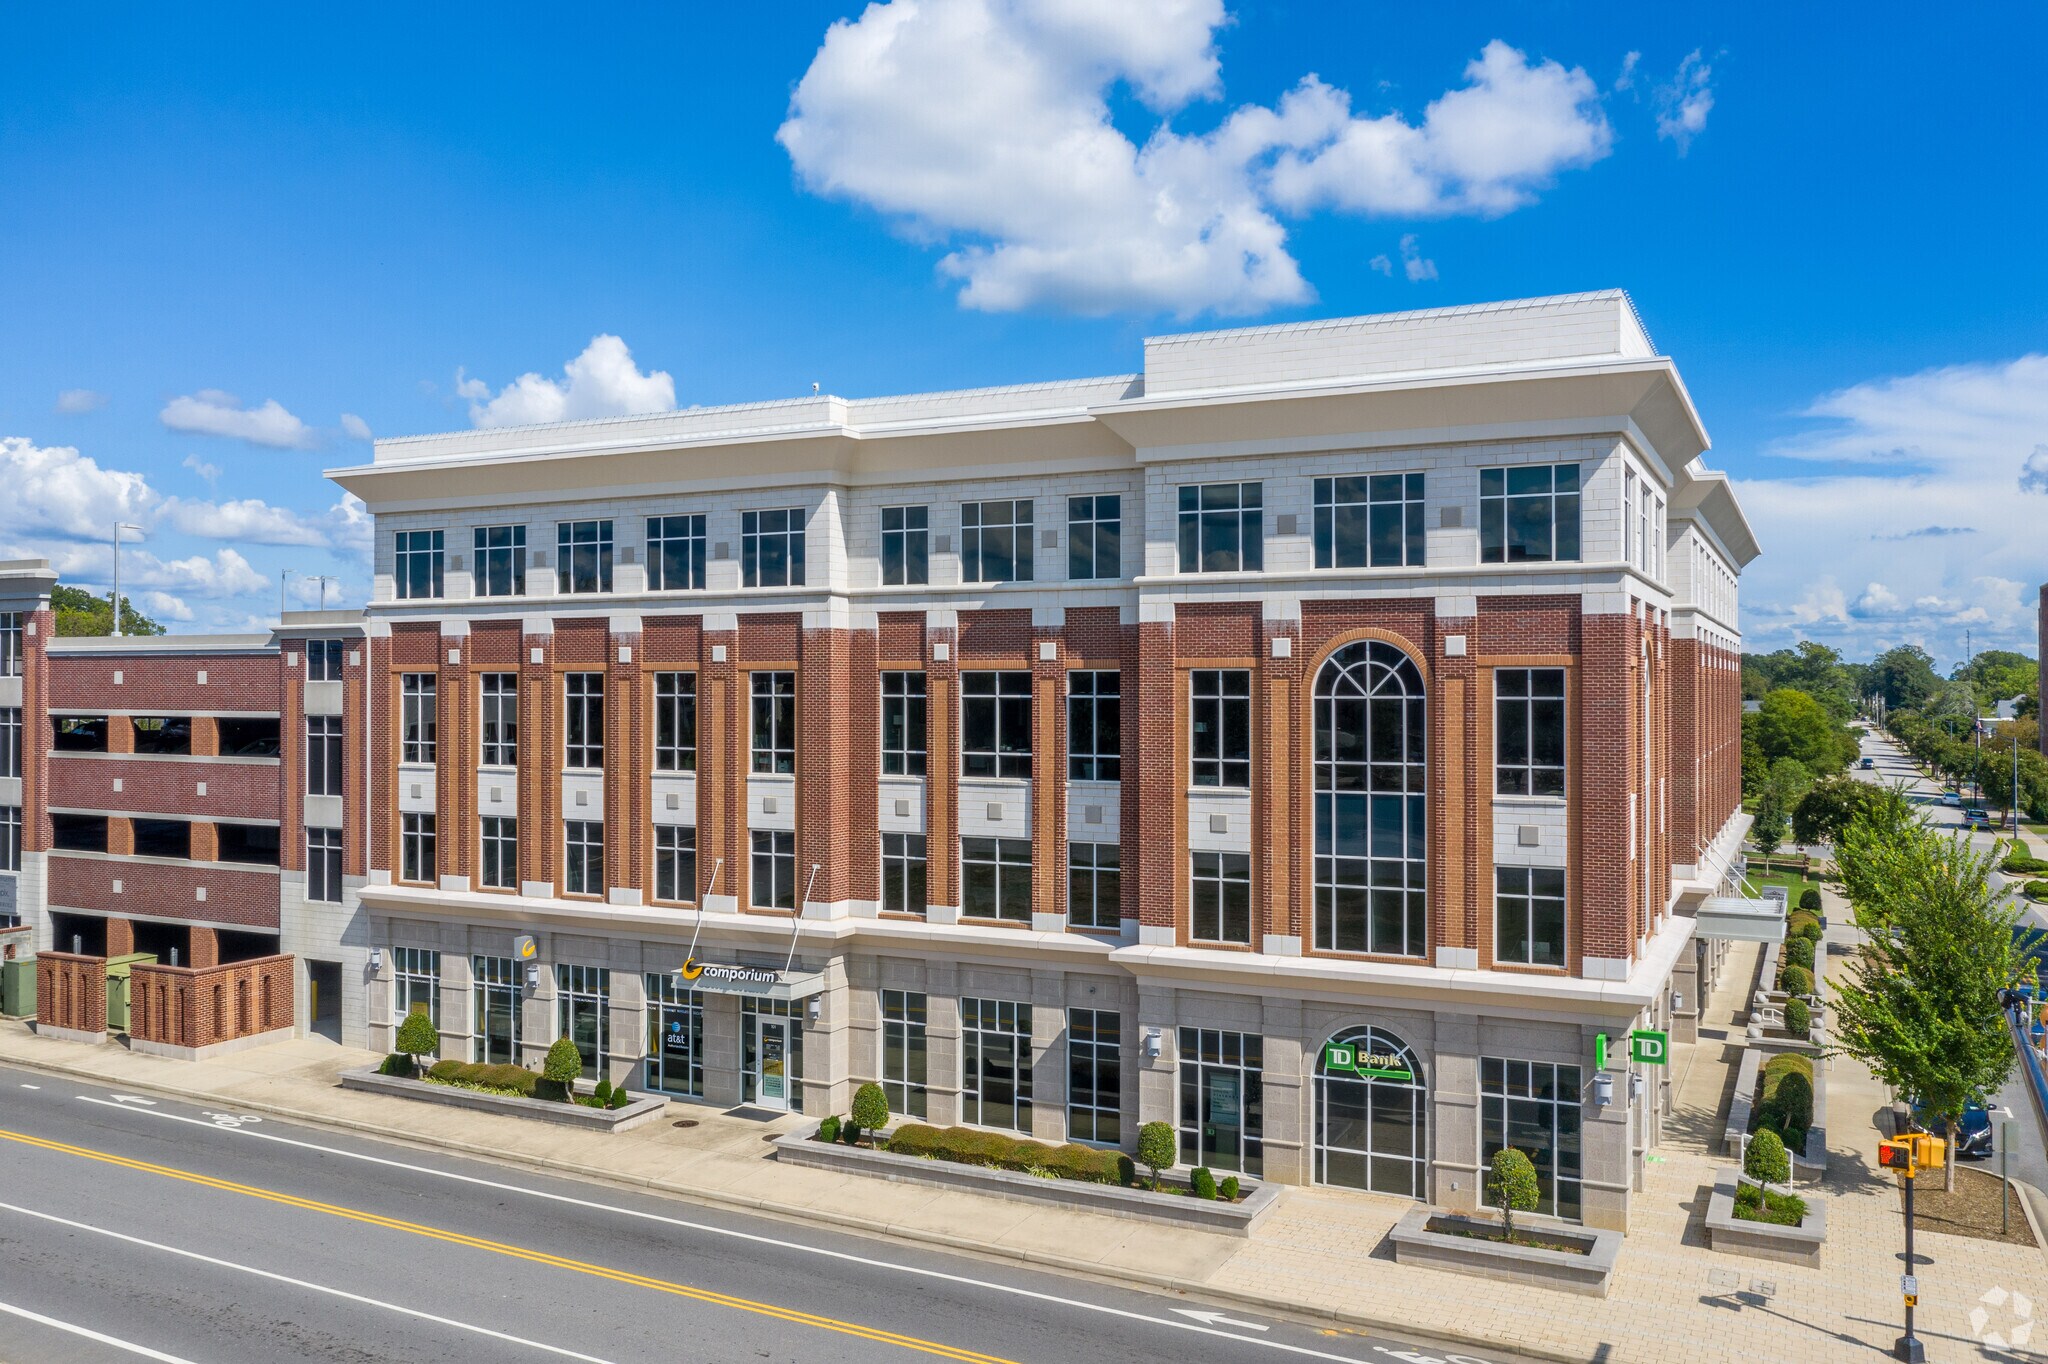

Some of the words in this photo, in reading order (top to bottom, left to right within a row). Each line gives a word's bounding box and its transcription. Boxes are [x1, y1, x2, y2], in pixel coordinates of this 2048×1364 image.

[703, 967, 775, 983] comporium
[667, 1033, 685, 1044] at&t
[1634, 1037, 1663, 1058] TD
[1329, 1048, 1351, 1065] TD
[1358, 1051, 1402, 1067] Bank
